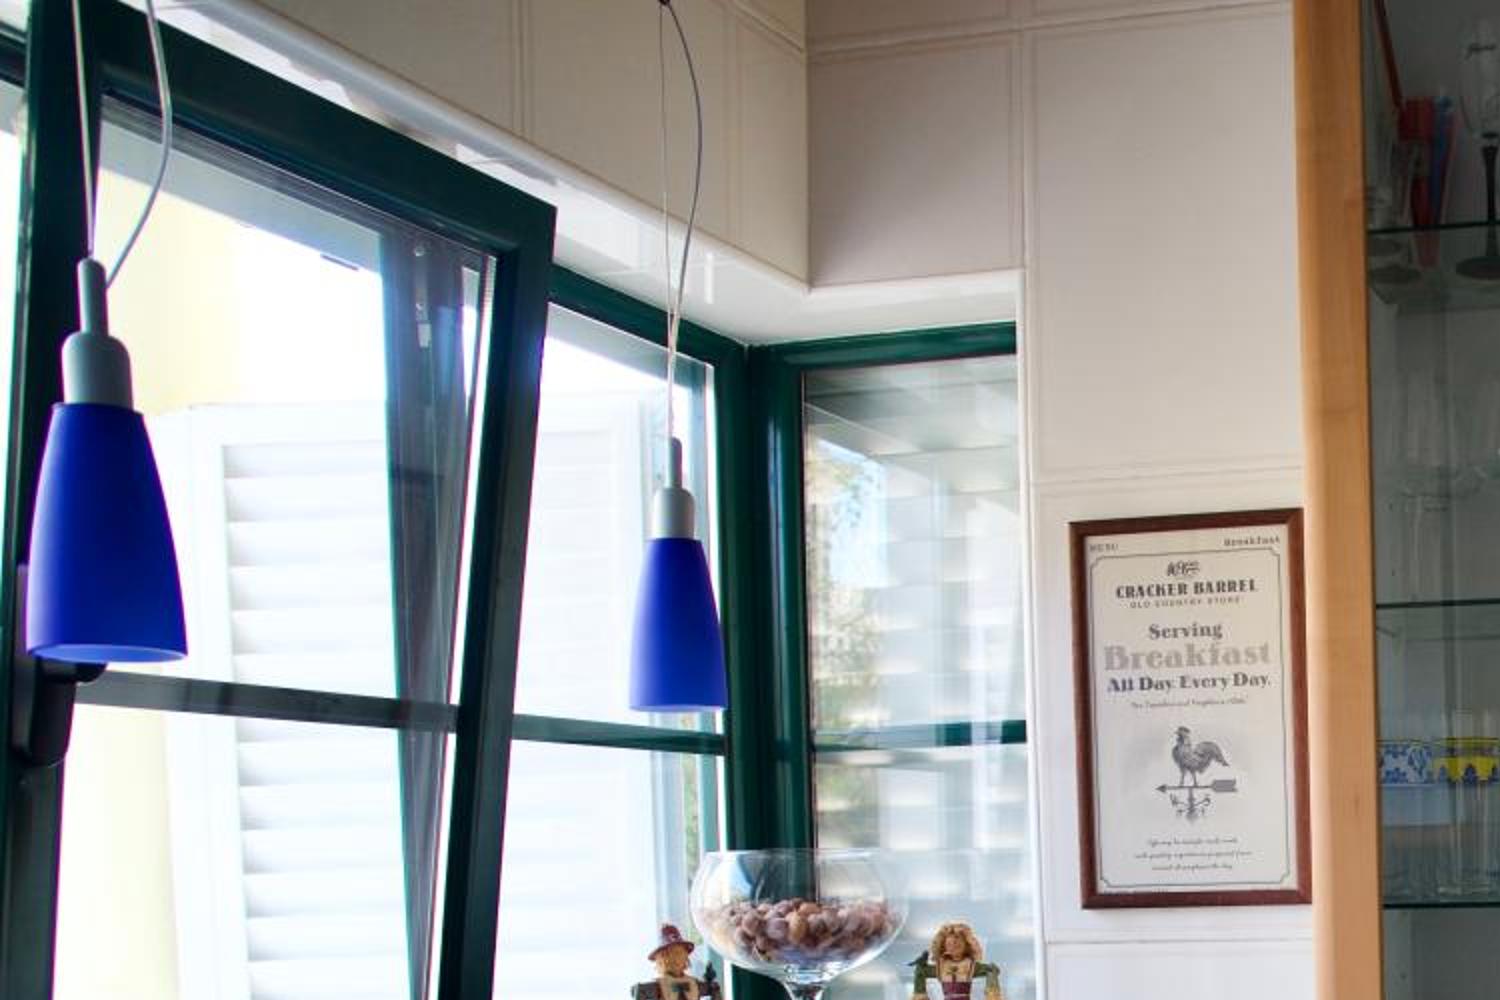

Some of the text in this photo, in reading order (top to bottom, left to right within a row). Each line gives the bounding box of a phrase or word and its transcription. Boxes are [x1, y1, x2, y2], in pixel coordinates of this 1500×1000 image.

[1115, 579, 1257, 599] CRACKER BARREL
[1149, 622, 1223, 641] Serving
[1103, 643, 1270, 671] Breakfast
[1107, 677, 1134, 692] All
[1179, 674, 1229, 691] Every
